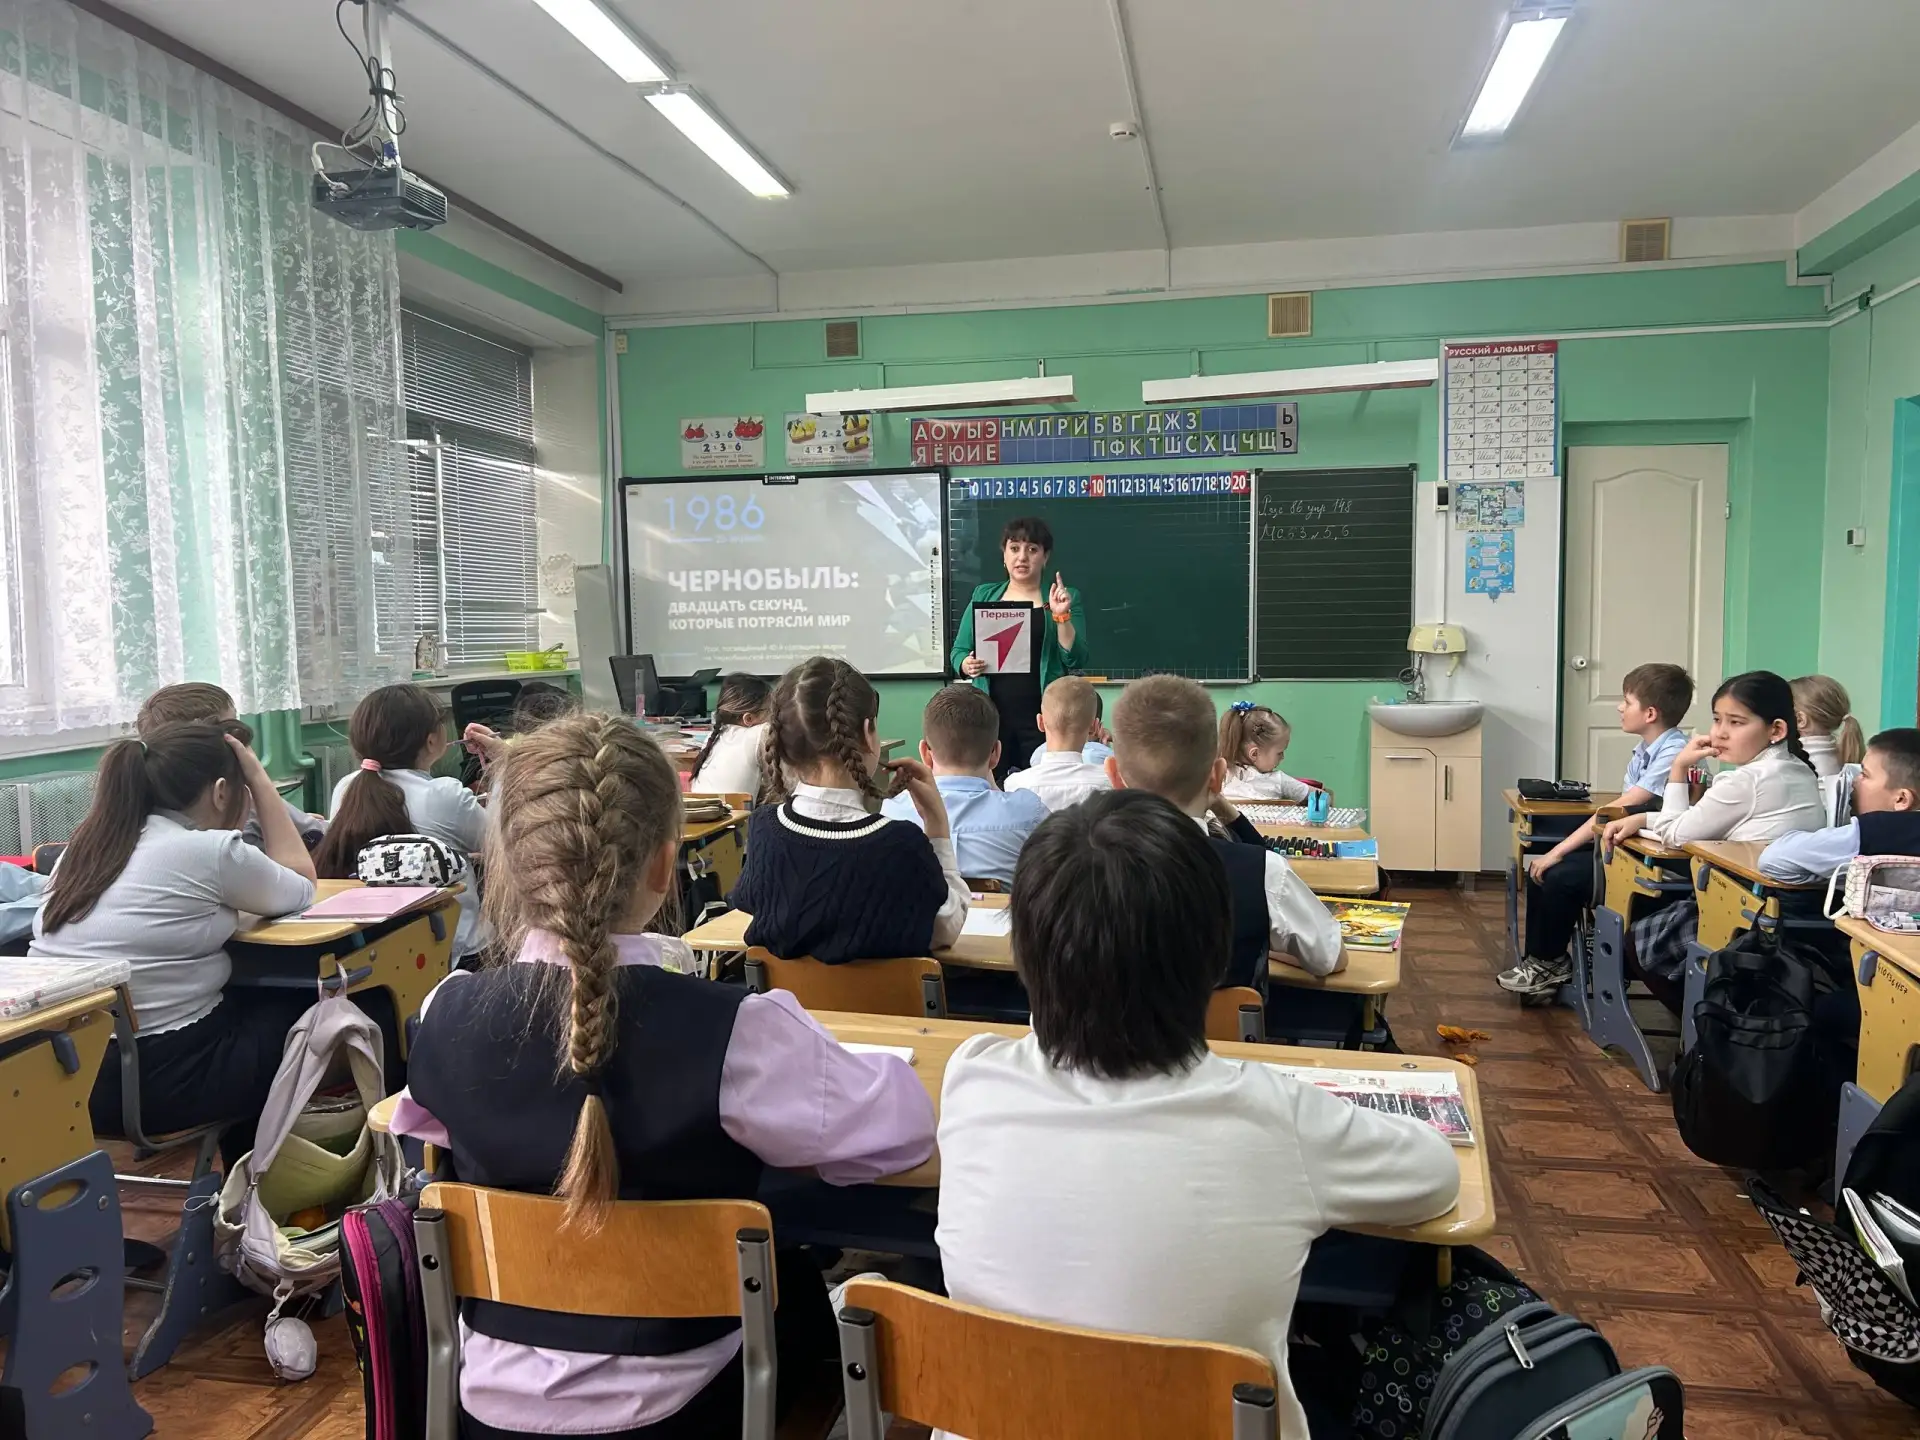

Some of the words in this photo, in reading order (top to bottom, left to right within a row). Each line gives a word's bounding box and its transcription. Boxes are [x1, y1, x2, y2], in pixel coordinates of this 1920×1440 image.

[1449, 346, 1491, 356] РУССКИЙ
[1493, 345, 1535, 353] АЛФАВИТ
[973, 482, 979, 496] 0
[984, 482, 990, 495] 1
[996, 481, 1002, 495] 2
[1007, 481, 1014, 495] 3
[1019, 481, 1027, 495] 4
[1031, 481, 1039, 495] 5
[1044, 480, 1051, 494] 6
[1056, 480, 1063, 494] 7
[1068, 479, 1076, 494] 8
[1080, 479, 1088, 494] 9
[1091, 479, 1103, 494] 10
[1106, 478, 1117, 494] 11
[1120, 478, 1132, 493] 12
[1134, 478, 1146, 493] 13
[1148, 477, 1160, 493] 14
[1162, 477, 1174, 493] 15
[1176, 477, 1188, 492] 16
[1190, 477, 1202, 492] 17
[1205, 476, 1217, 491] 18
[1219, 475, 1231, 491] 19
[1232, 475, 1246, 490] 20
[663, 494, 765, 532] 1986
[1333, 498, 1353, 513] 148
[668, 566, 860, 592] ЧЕРНОБЫЛЬ:
[668, 600, 746, 615] ДВАДЦАТЬ
[749, 598, 808, 613] СЕКУНД,
[980, 610, 1025, 620] Первые
[668, 617, 734, 631] КОТОРЫЕ
[738, 615, 814, 629] ПОТРЯСЛИ
[817, 614, 852, 628] МИР
